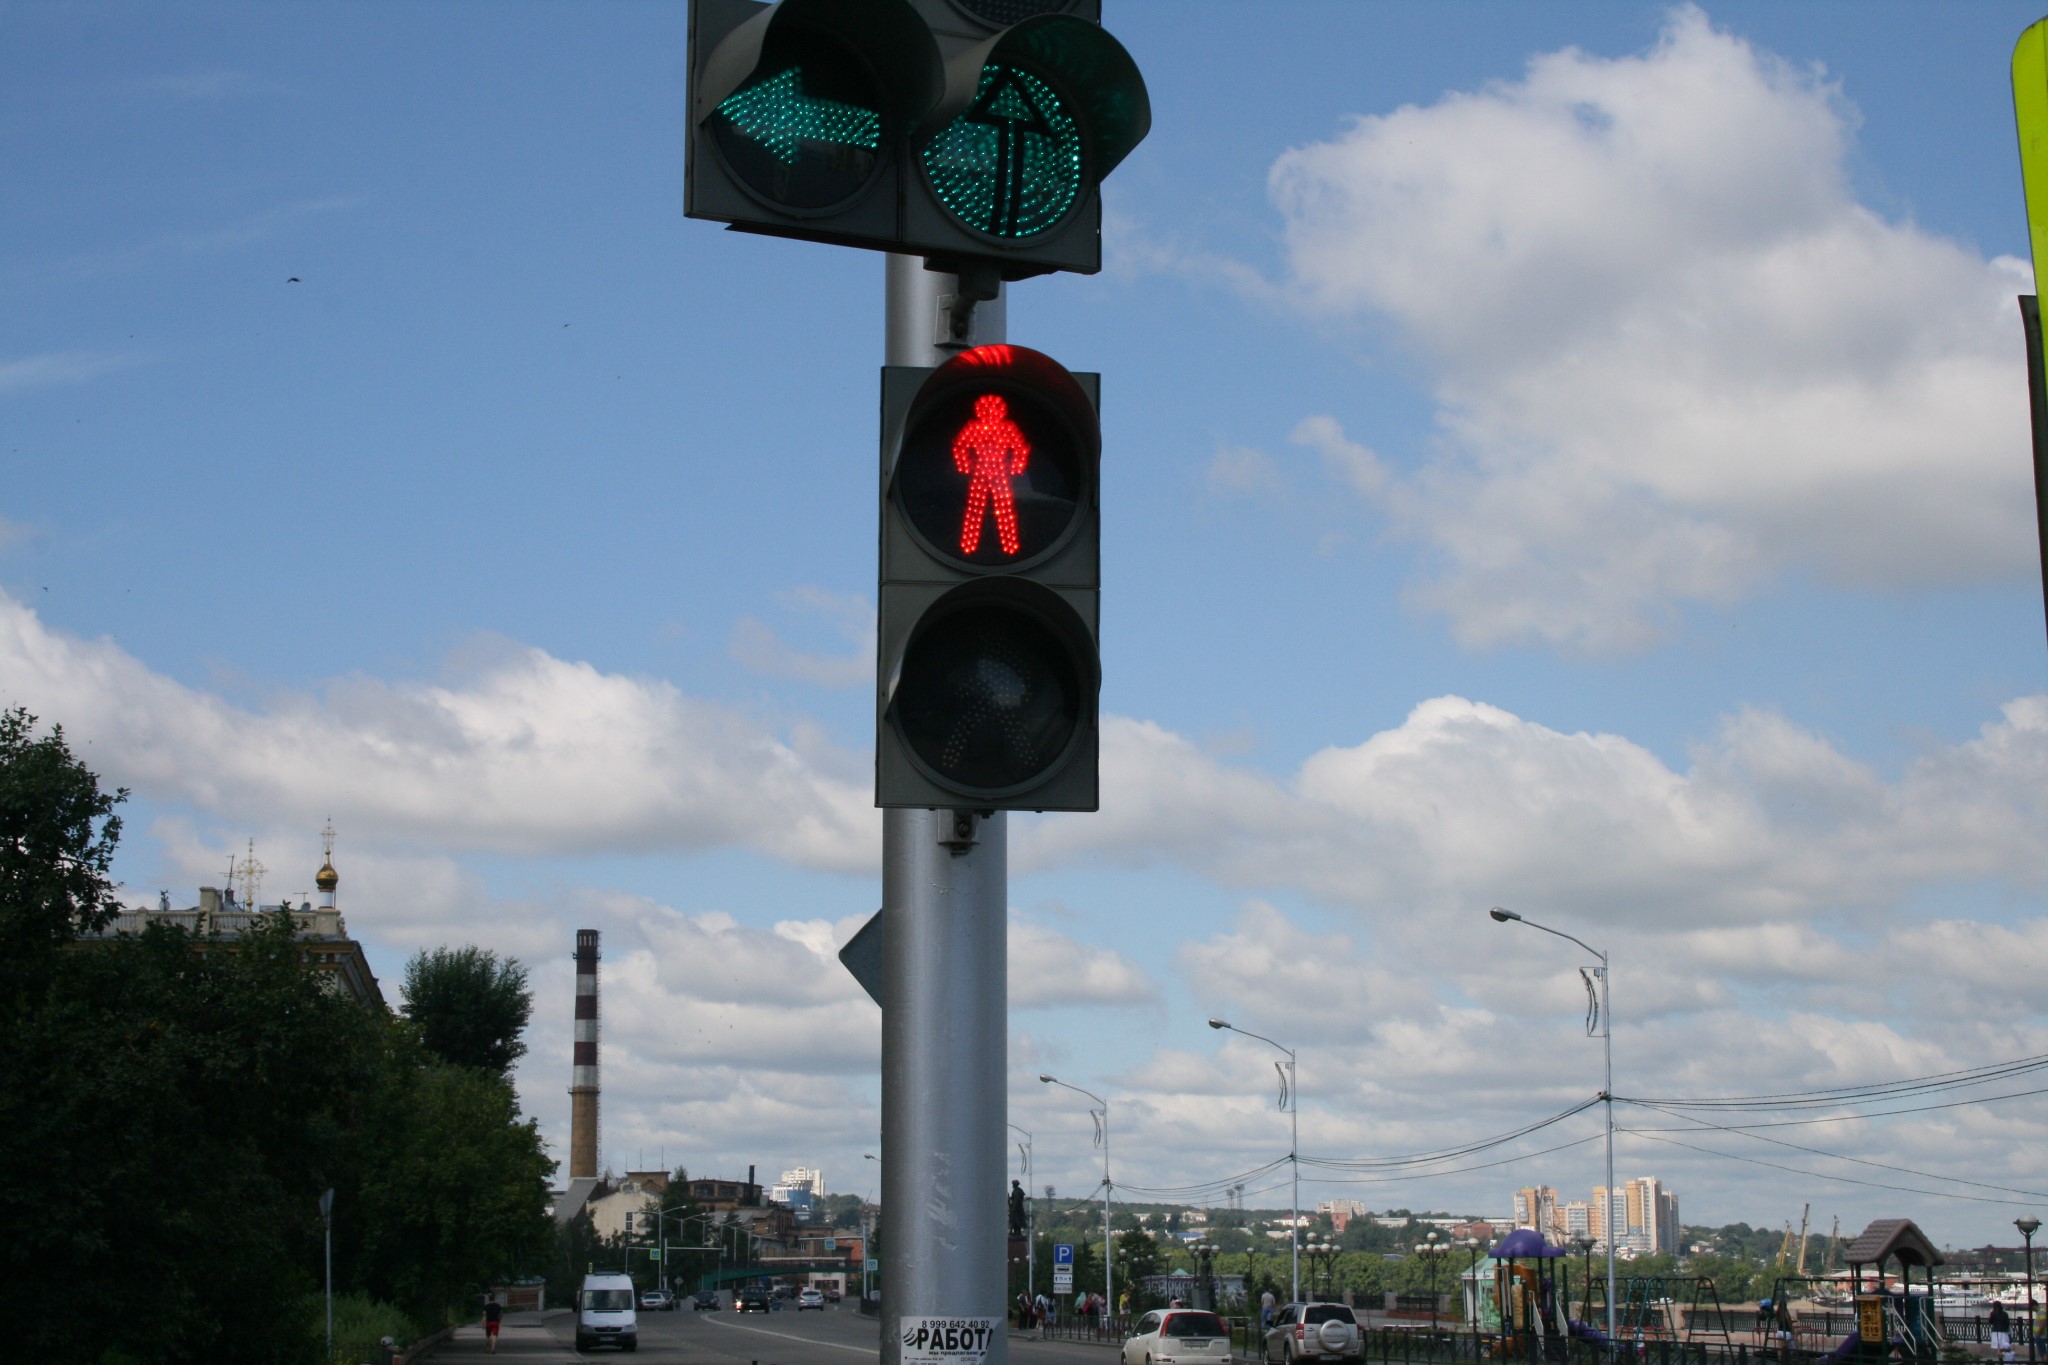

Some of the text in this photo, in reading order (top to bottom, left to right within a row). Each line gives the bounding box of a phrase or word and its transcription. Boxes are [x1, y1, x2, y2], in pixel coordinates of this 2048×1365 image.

[1059, 1247, 1070, 1262] P
[922, 1320, 989, 1328] 8 999 642 40 92
